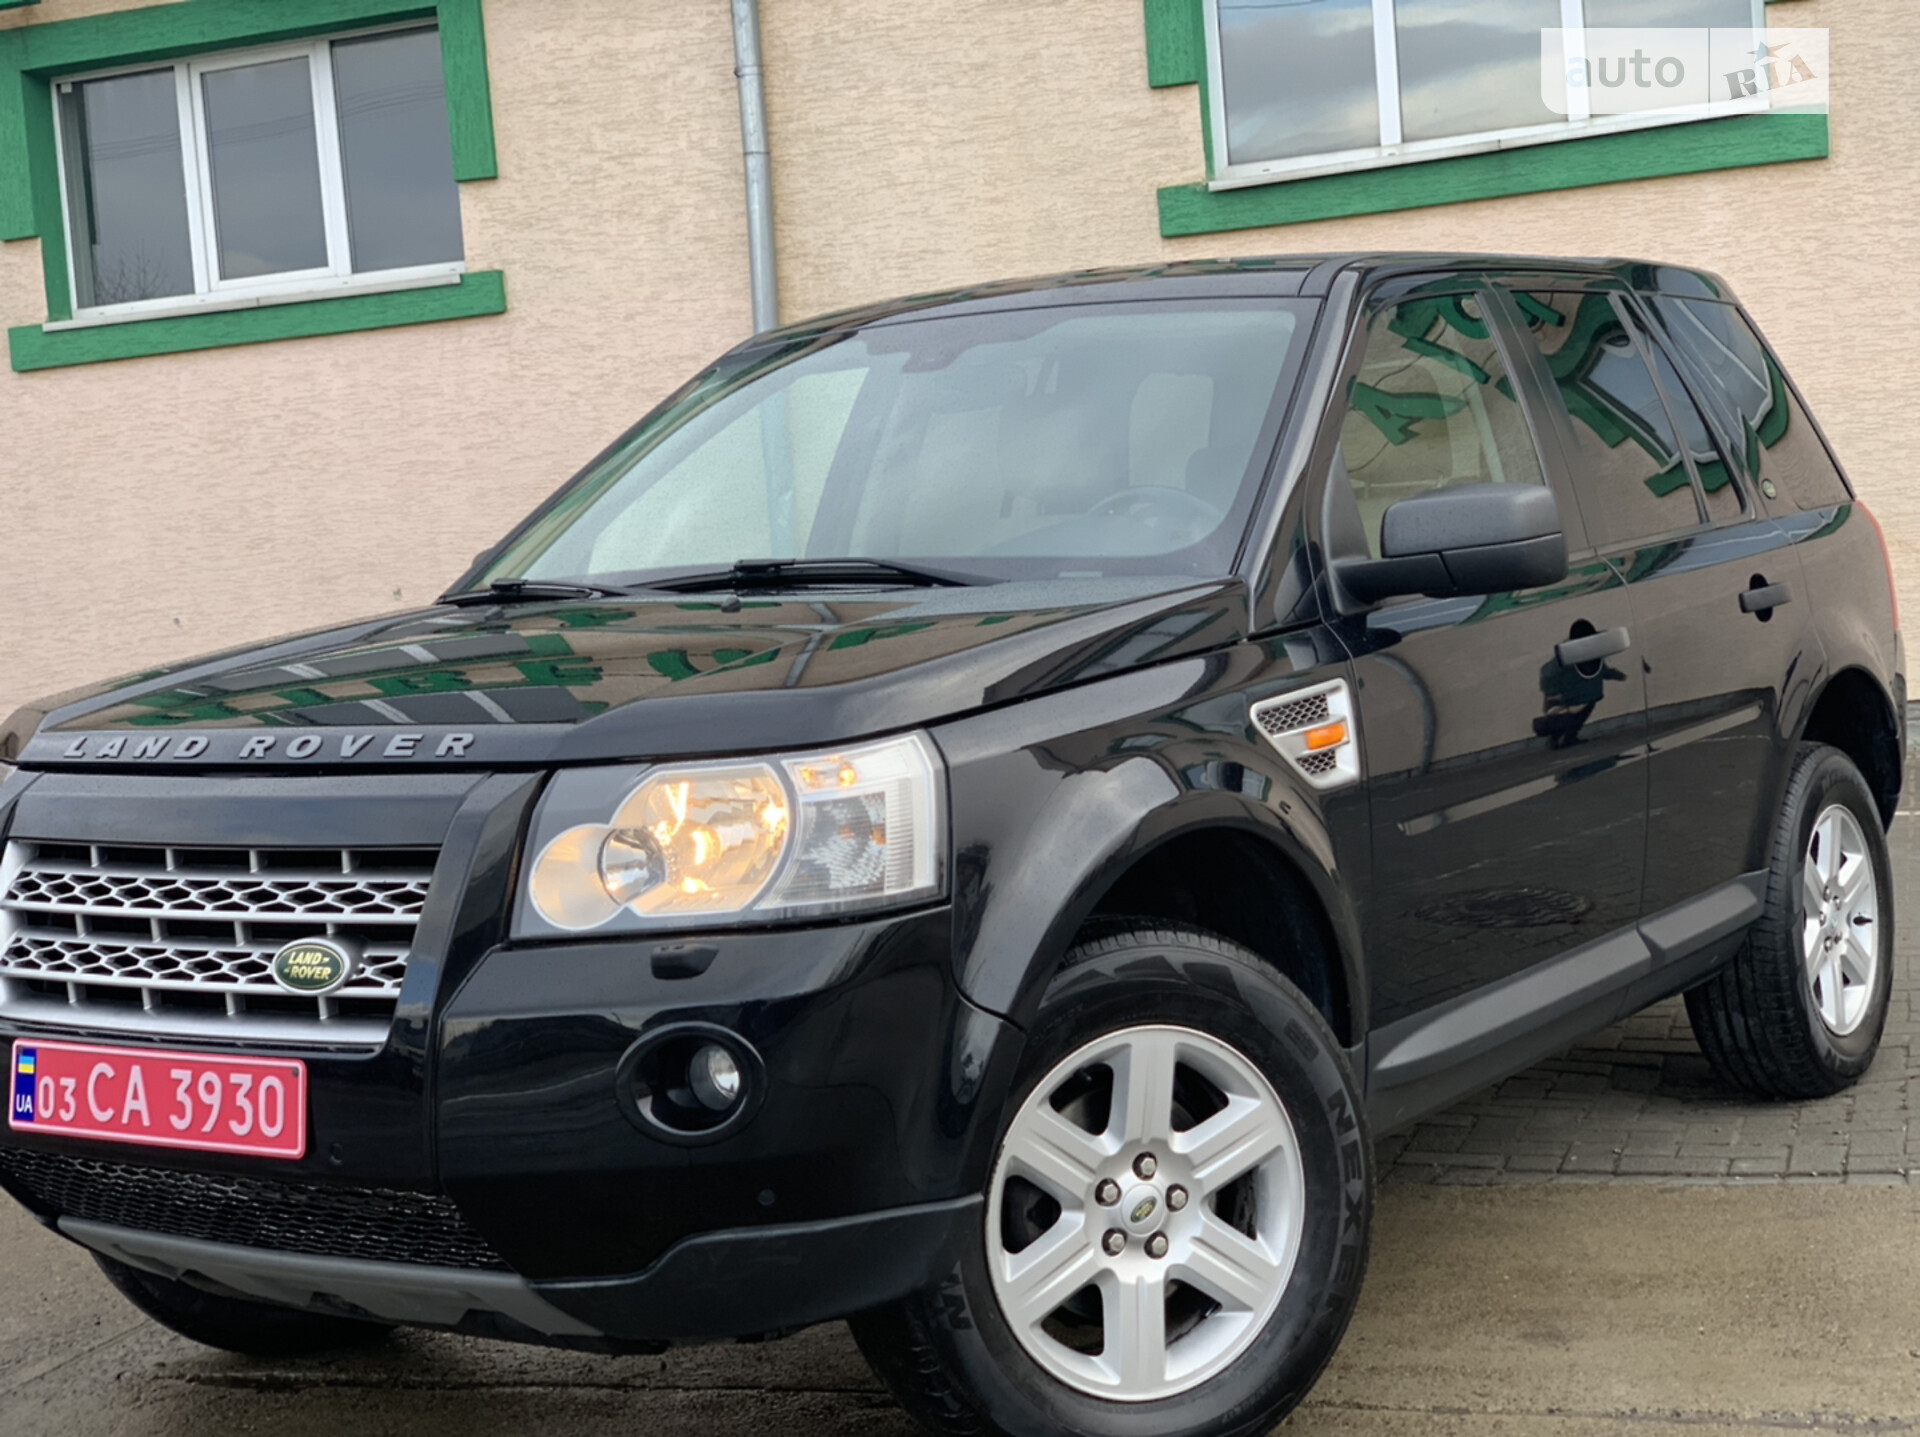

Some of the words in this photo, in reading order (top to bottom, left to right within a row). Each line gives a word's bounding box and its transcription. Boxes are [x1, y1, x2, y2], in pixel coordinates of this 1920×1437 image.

[63, 736, 210, 759] LAND
[238, 732, 476, 759] ROVER
[16, 1094, 33, 1114] UA
[169, 1068, 285, 1138] 3930
